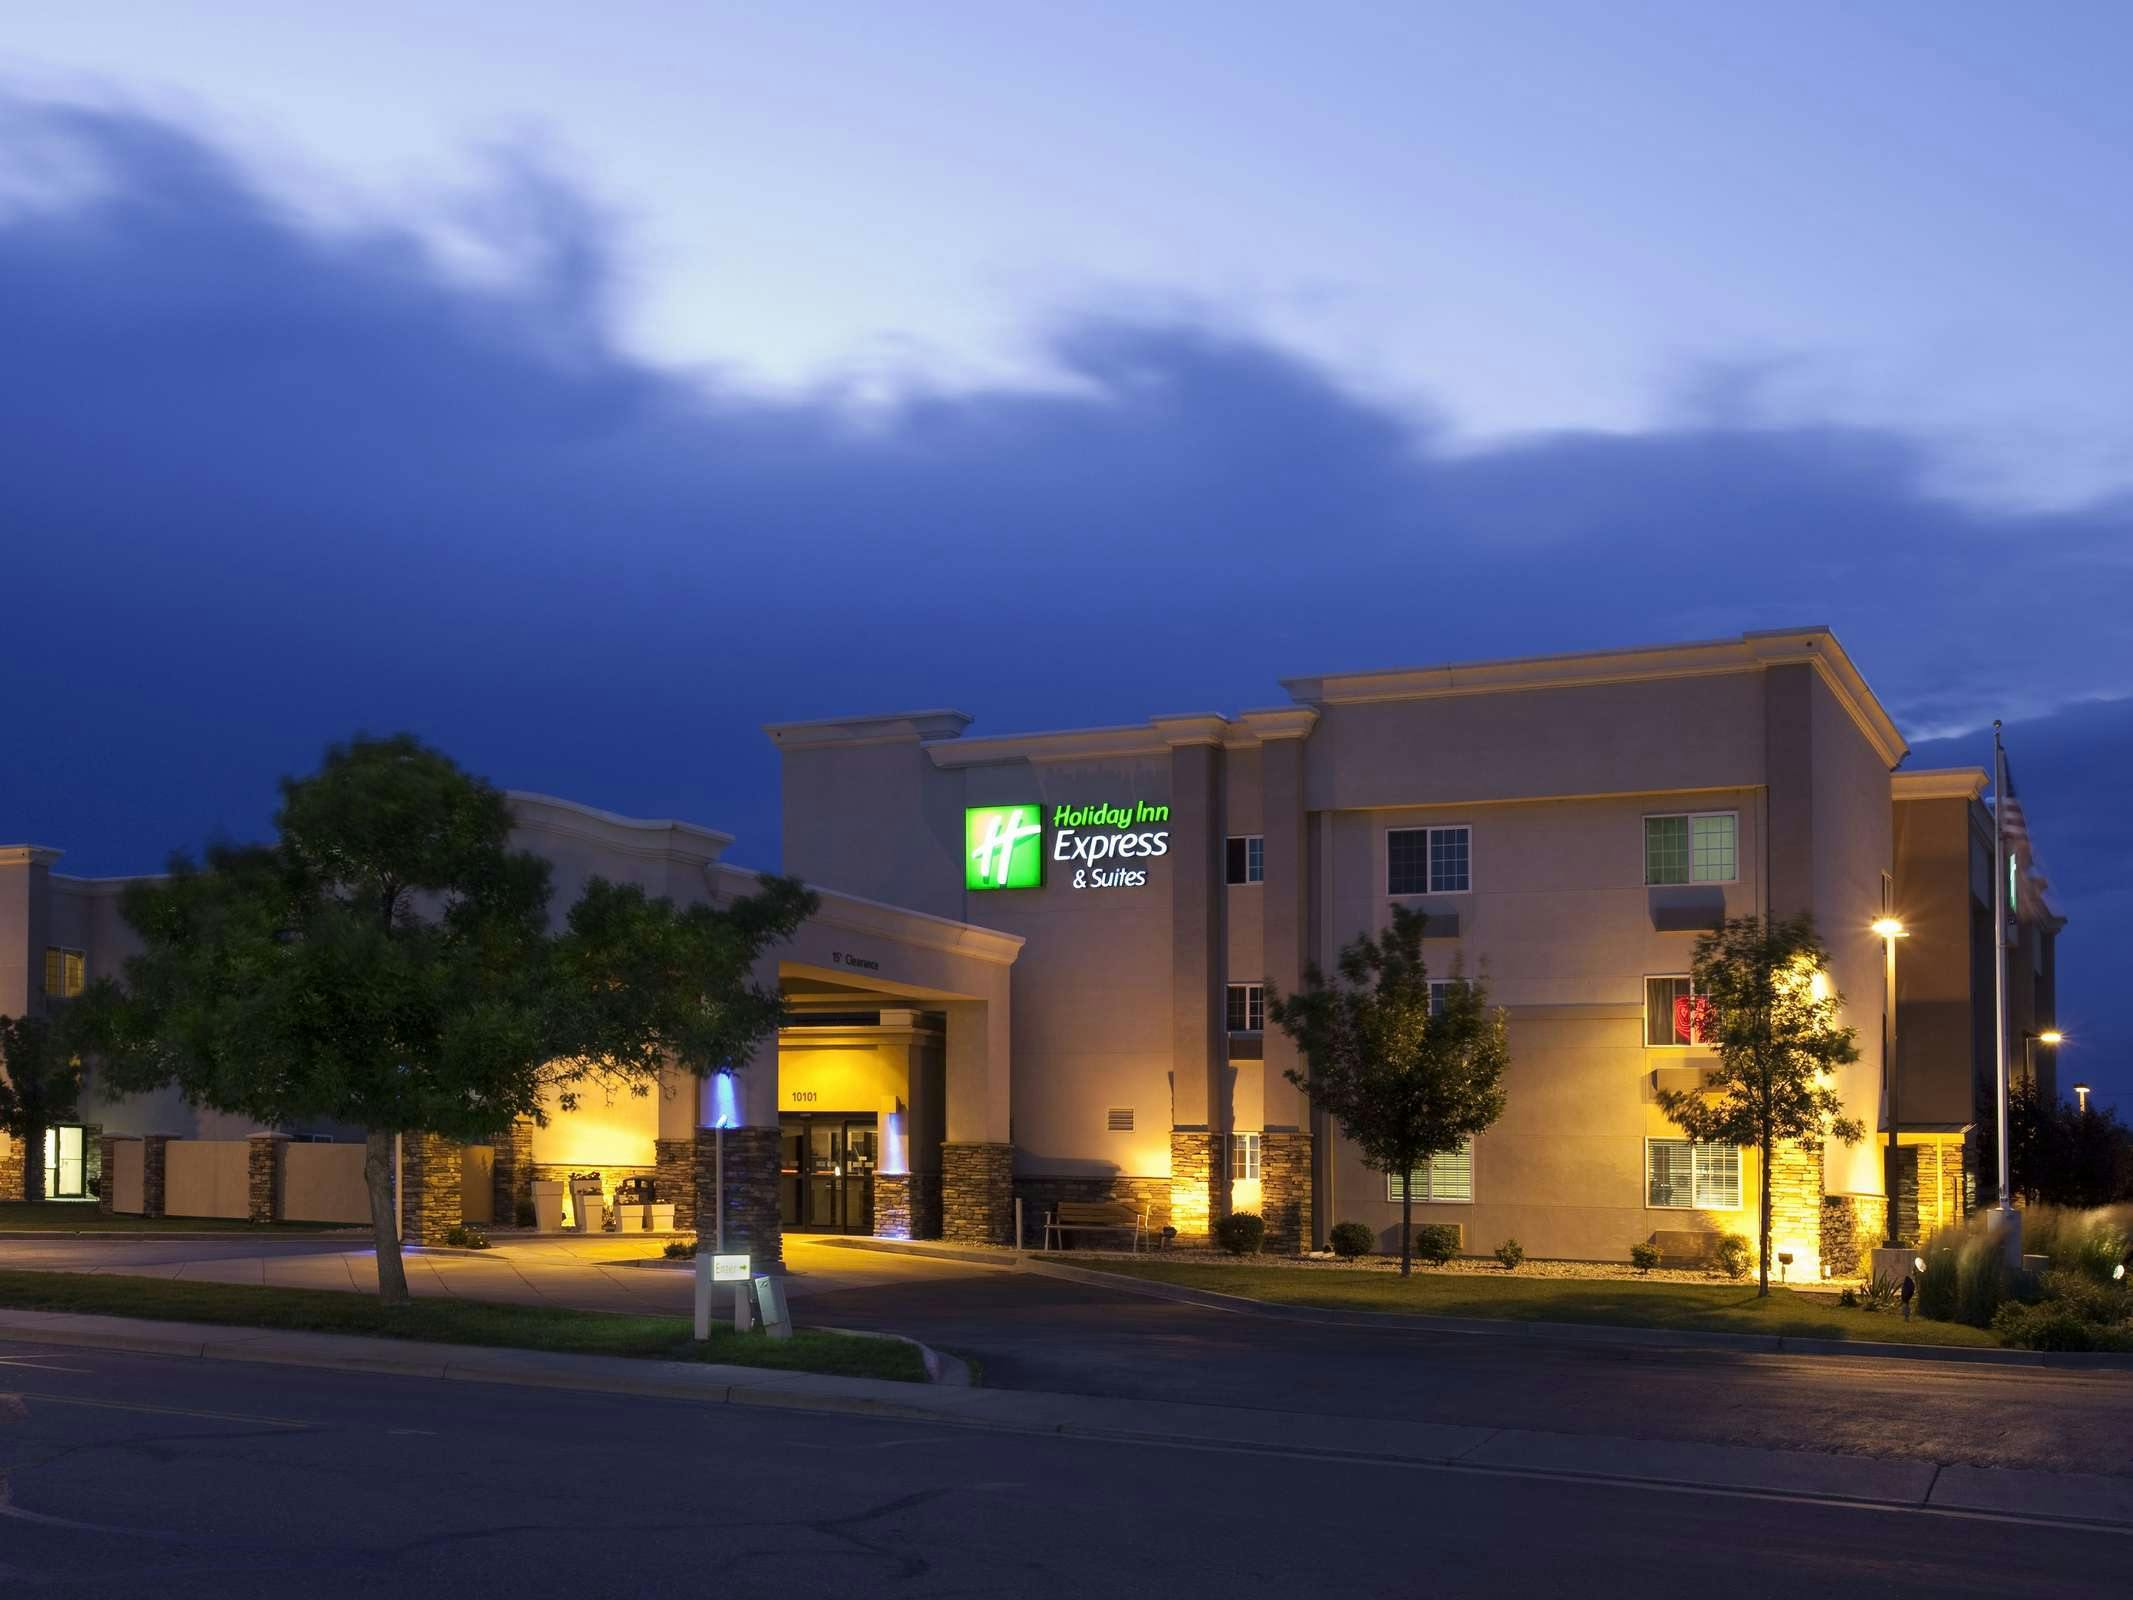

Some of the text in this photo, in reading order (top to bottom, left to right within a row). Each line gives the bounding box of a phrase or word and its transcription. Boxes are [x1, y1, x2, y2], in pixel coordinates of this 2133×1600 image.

[1053, 800, 1169, 829] Holiday Inn
[1053, 830, 1169, 867] Express
[1073, 868, 1146, 889] & Suites
[845, 953, 879, 970] Clearance
[792, 1092, 817, 1102] 10101
